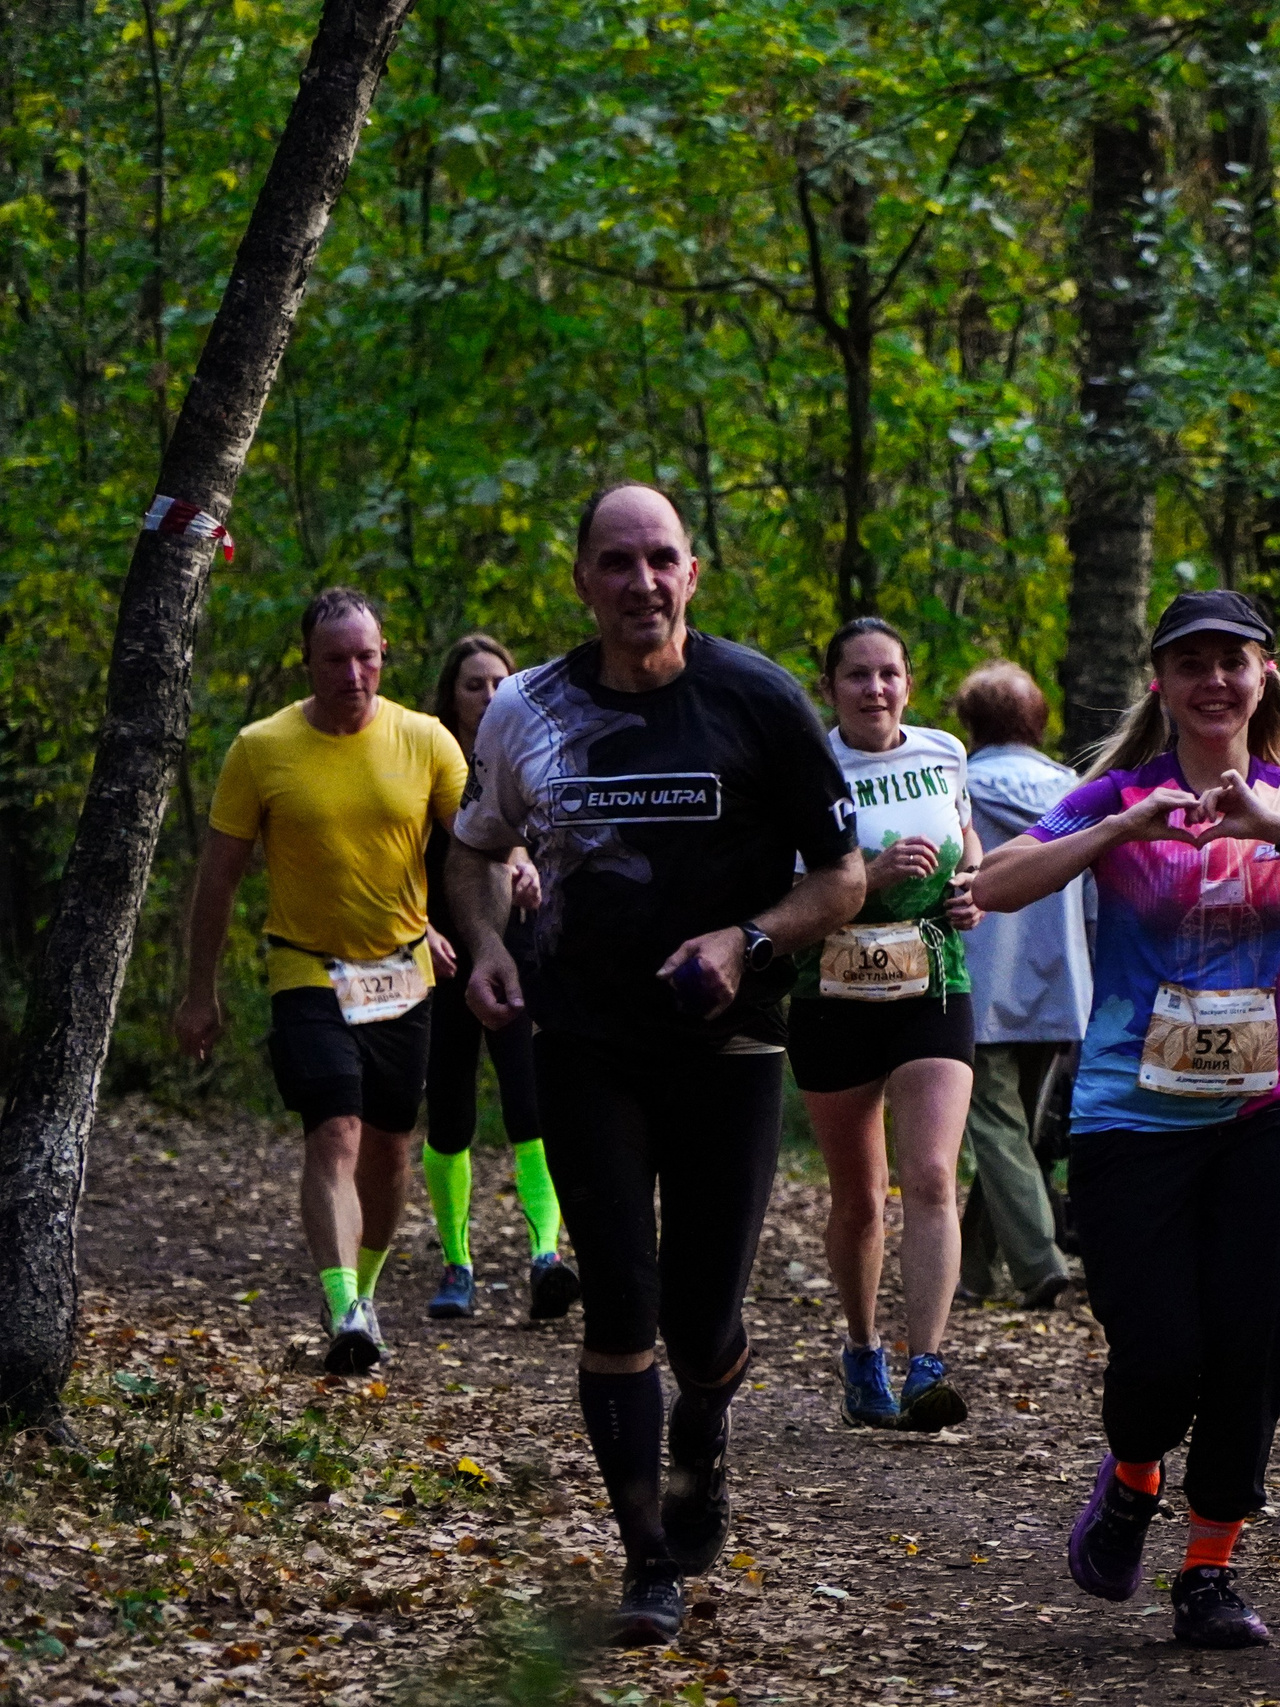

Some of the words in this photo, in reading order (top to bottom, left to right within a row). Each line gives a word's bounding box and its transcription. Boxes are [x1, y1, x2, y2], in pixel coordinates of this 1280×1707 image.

[587, 791, 647, 807] ELTON
[651, 789, 707, 805] ULTRA
[859, 949, 888, 969] 10
[360, 976, 393, 994] 127
[843, 970, 903, 982] Светлана
[1195, 1028, 1232, 1054] 52
[1192, 1059, 1230, 1070] Юлия
